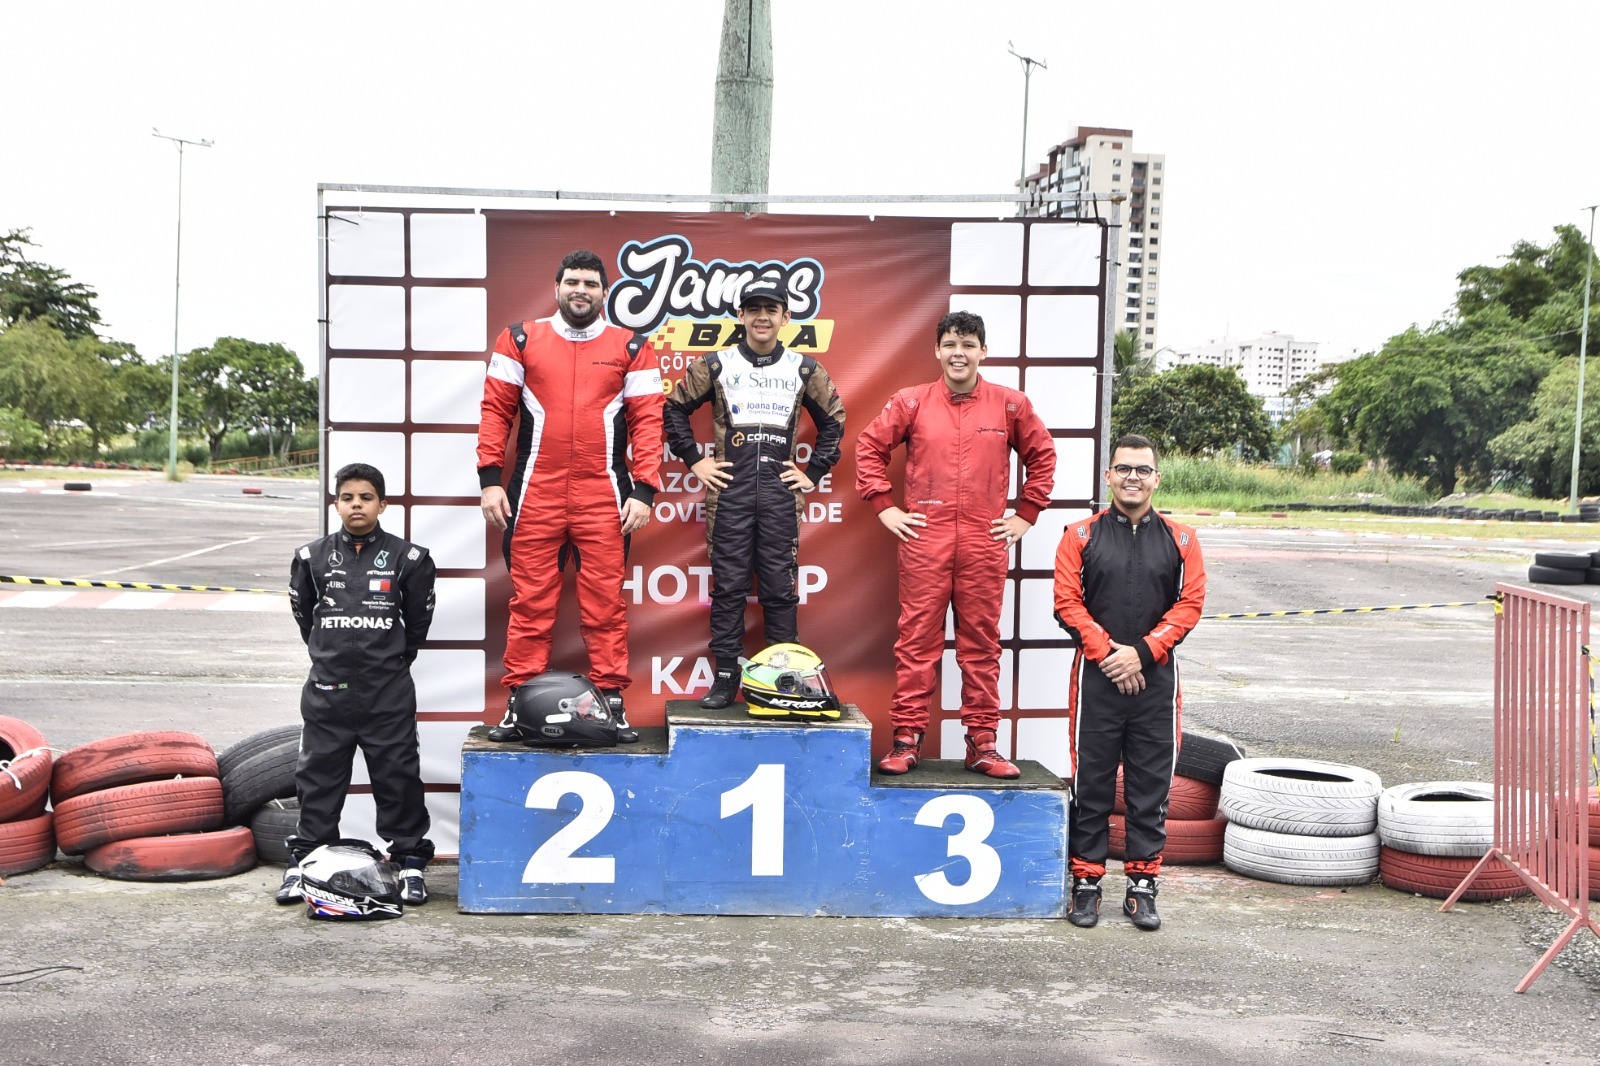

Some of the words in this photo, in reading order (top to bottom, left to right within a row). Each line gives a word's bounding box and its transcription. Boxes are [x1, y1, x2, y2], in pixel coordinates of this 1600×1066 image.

[688, 323, 818, 348] BAA
[749, 372, 797, 392] Samel
[746, 402, 770, 410] Joana
[772, 402, 790, 412] Darc
[329, 581, 346, 589] UBS
[321, 616, 393, 629] PETRONAS
[521, 770, 616, 885] 2
[719, 763, 785, 877] 1
[913, 794, 1002, 906] 3
